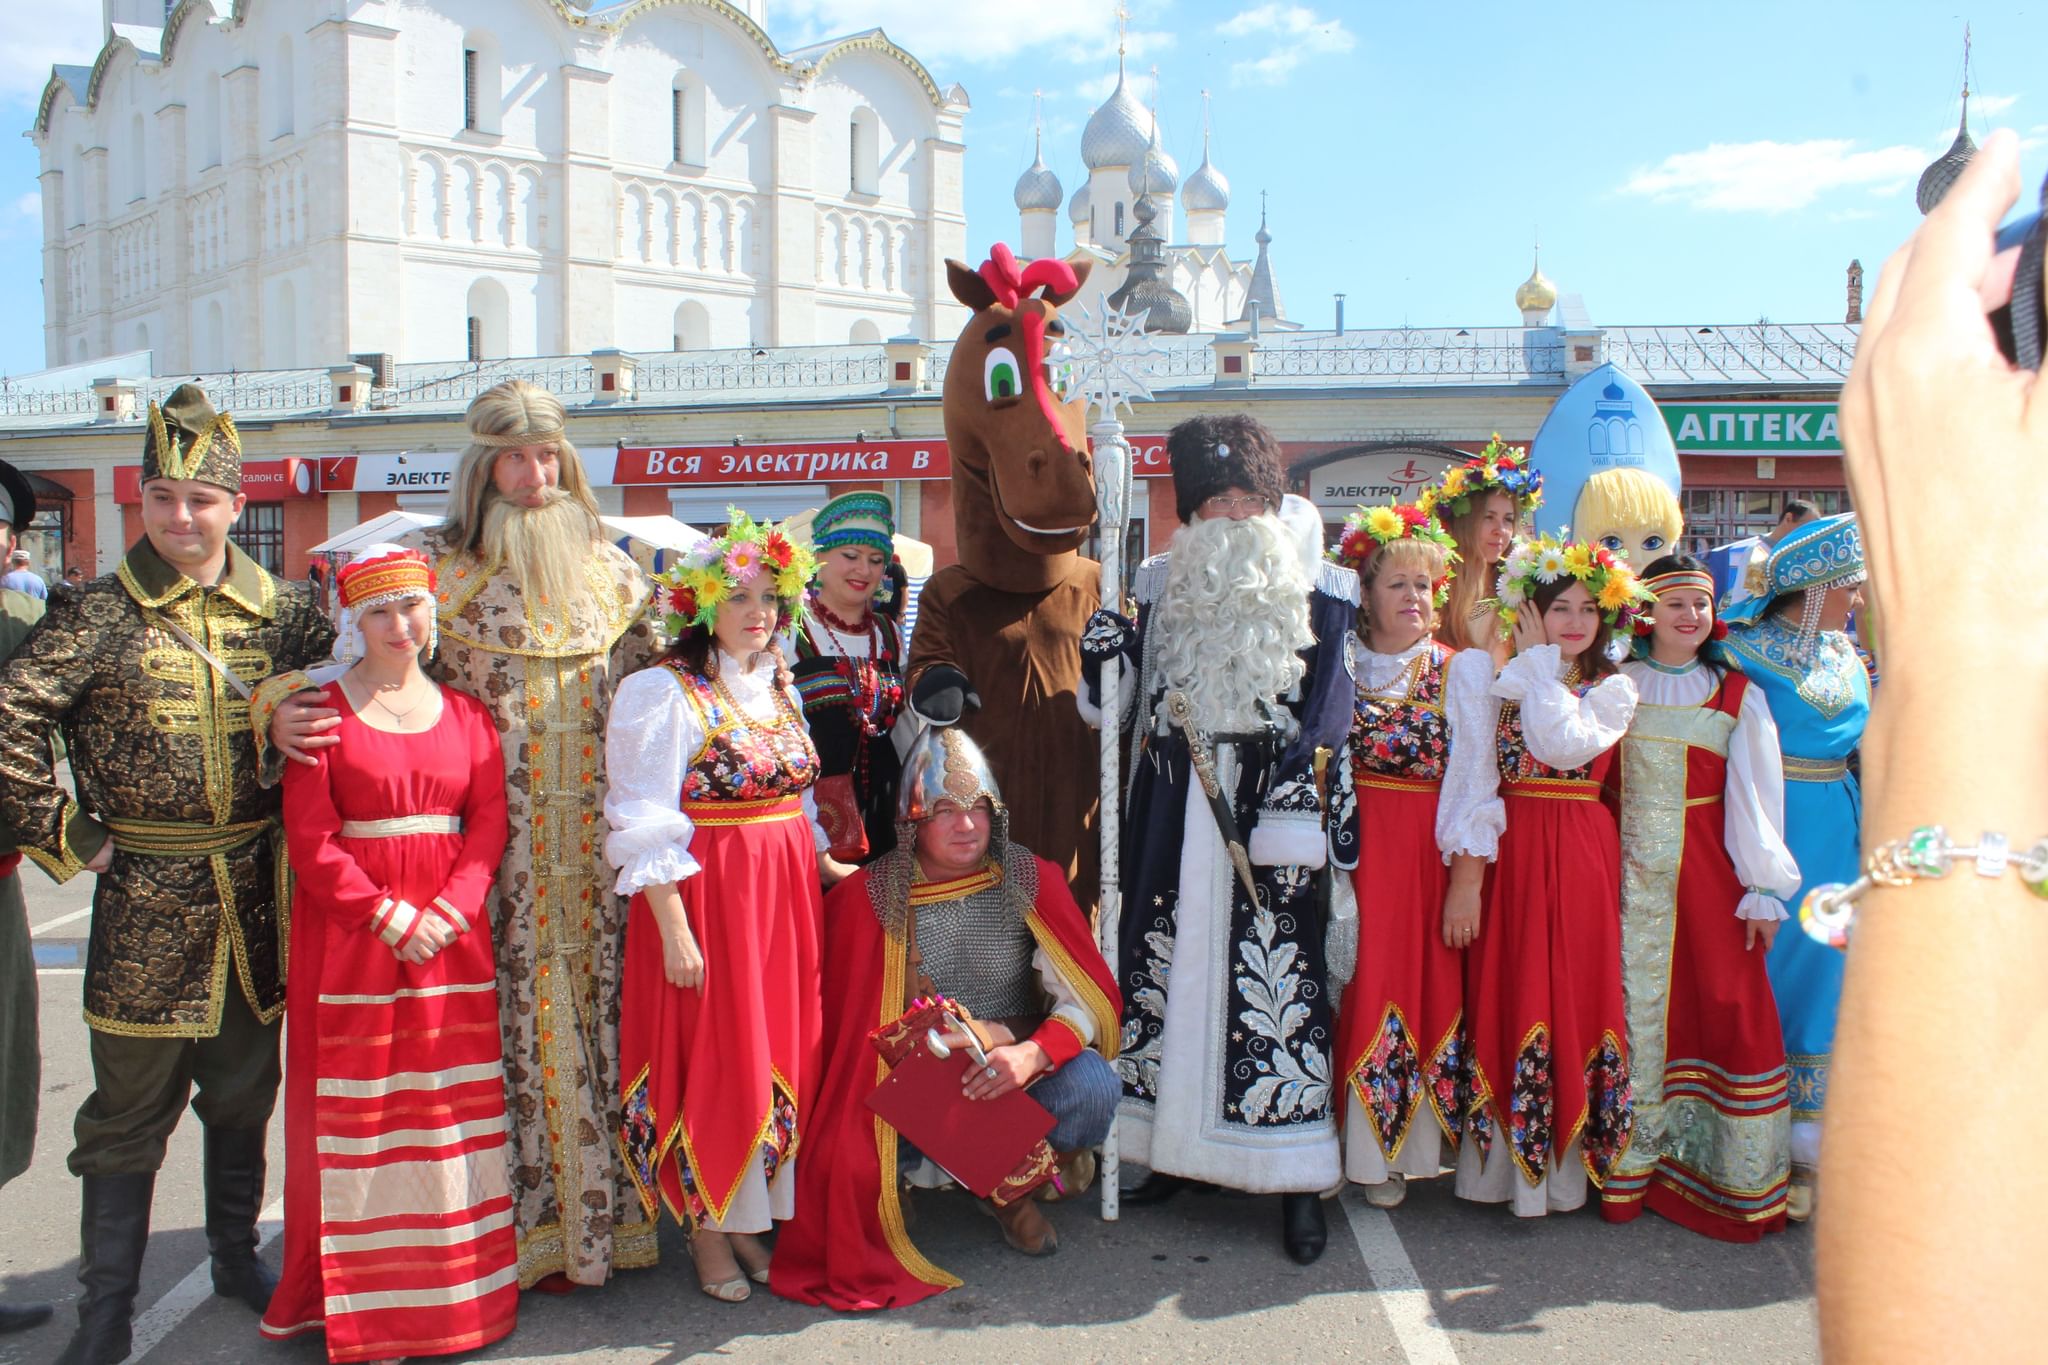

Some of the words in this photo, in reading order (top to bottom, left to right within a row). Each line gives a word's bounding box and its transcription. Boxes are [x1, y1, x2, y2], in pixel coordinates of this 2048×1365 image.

[1676, 413, 1840, 442] АПТЕКА
[645, 450, 702, 475] Вся
[718, 450, 888, 480] электрика
[911, 449, 930, 469] в
[242, 473, 272, 483] салон
[1324, 486, 1402, 497] ЭЛЕКТРО
